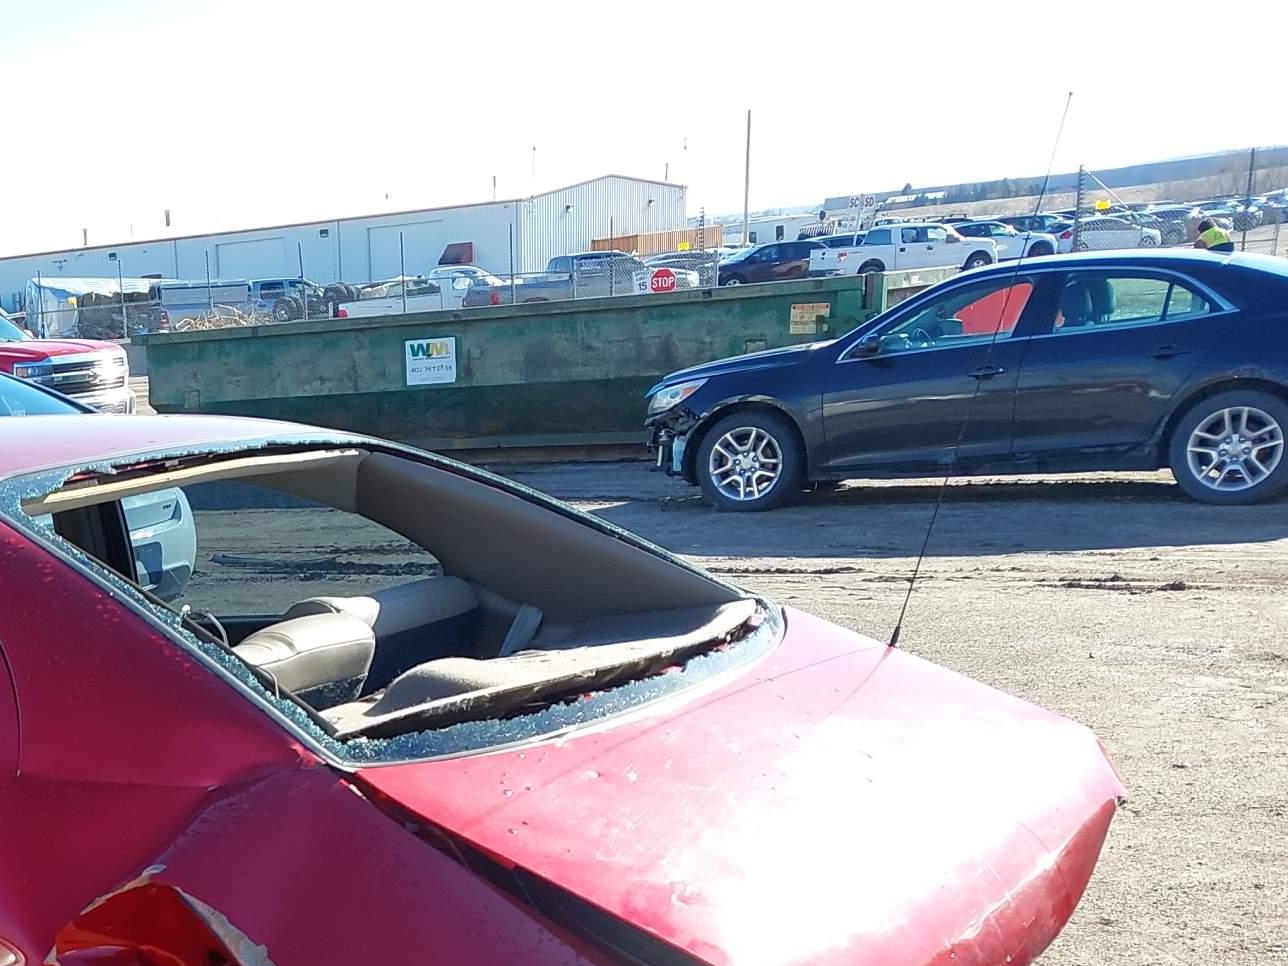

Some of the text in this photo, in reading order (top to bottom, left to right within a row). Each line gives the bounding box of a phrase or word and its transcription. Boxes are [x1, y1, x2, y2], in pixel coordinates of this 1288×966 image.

[849, 197, 860, 208] SC
[864, 196, 874, 207] SD
[638, 281, 648, 291] 15
[652, 276, 674, 288] STOP
[409, 343, 449, 357] WM
